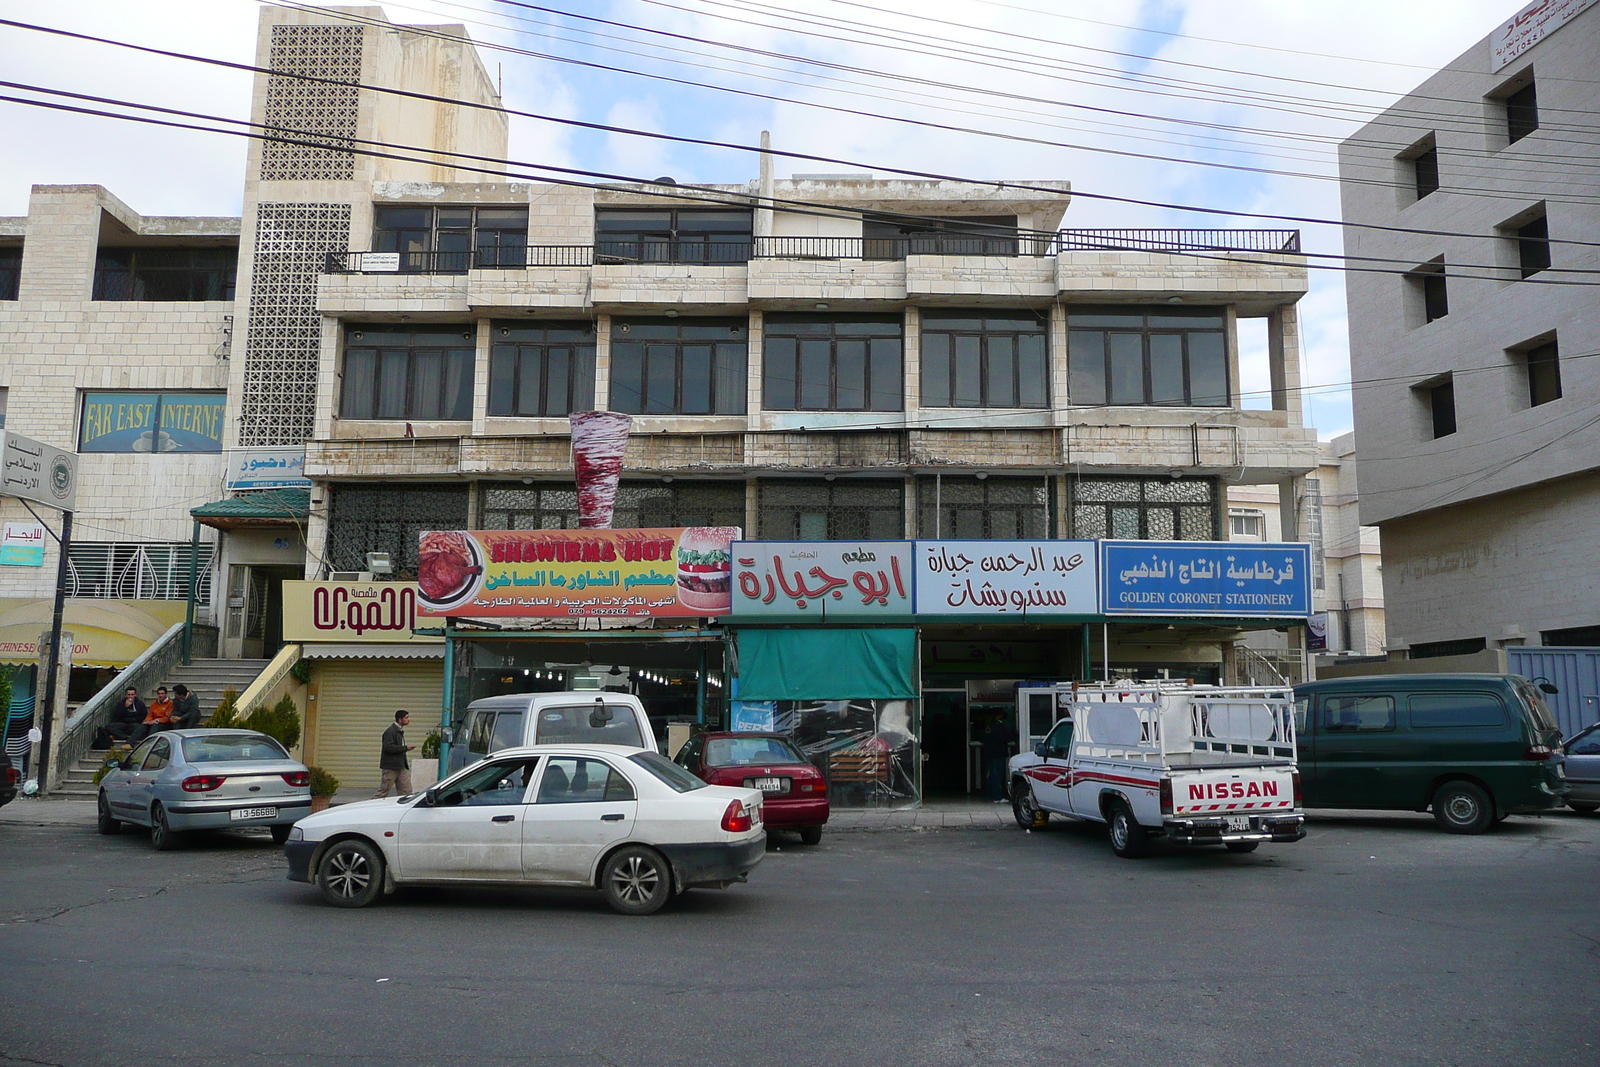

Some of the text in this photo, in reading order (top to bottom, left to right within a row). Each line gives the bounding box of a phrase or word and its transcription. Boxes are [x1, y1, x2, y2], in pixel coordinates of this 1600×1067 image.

[84, 403, 113, 444] FAR
[116, 403, 153, 431] EAST
[7, 439, 43, 459] البنك
[5, 457, 41, 473] الاسلامي
[3, 474, 40, 490] الاردني
[4, 527, 43, 543] للايجار
[490, 539, 675, 564] SHAWIRMA HOT
[841, 547, 876, 565] مطعم
[927, 546, 1084, 578] عبد الرحمن جبارة
[1119, 554, 1295, 588] قرطاسية التاج الذهبي
[484, 569, 676, 591] مطعم الشاورما الساخن
[737, 555, 907, 607] ابو جبارة
[350, 586, 378, 598] محمصة
[946, 578, 1068, 612] سندويشات
[1119, 591, 1295, 606] GOLDEN CORONET STATIONERY
[473, 596, 516, 608] الطازجة
[517, 596, 554, 607] العالمية
[561, 596, 600, 608] العربية
[602, 595, 647, 607] المأكولات
[648, 595, 677, 608] أشهى
[313, 586, 416, 636] الحموي
[0, 642, 36, 653] CHINESE
[1188, 780, 1279, 800] NISSAN
